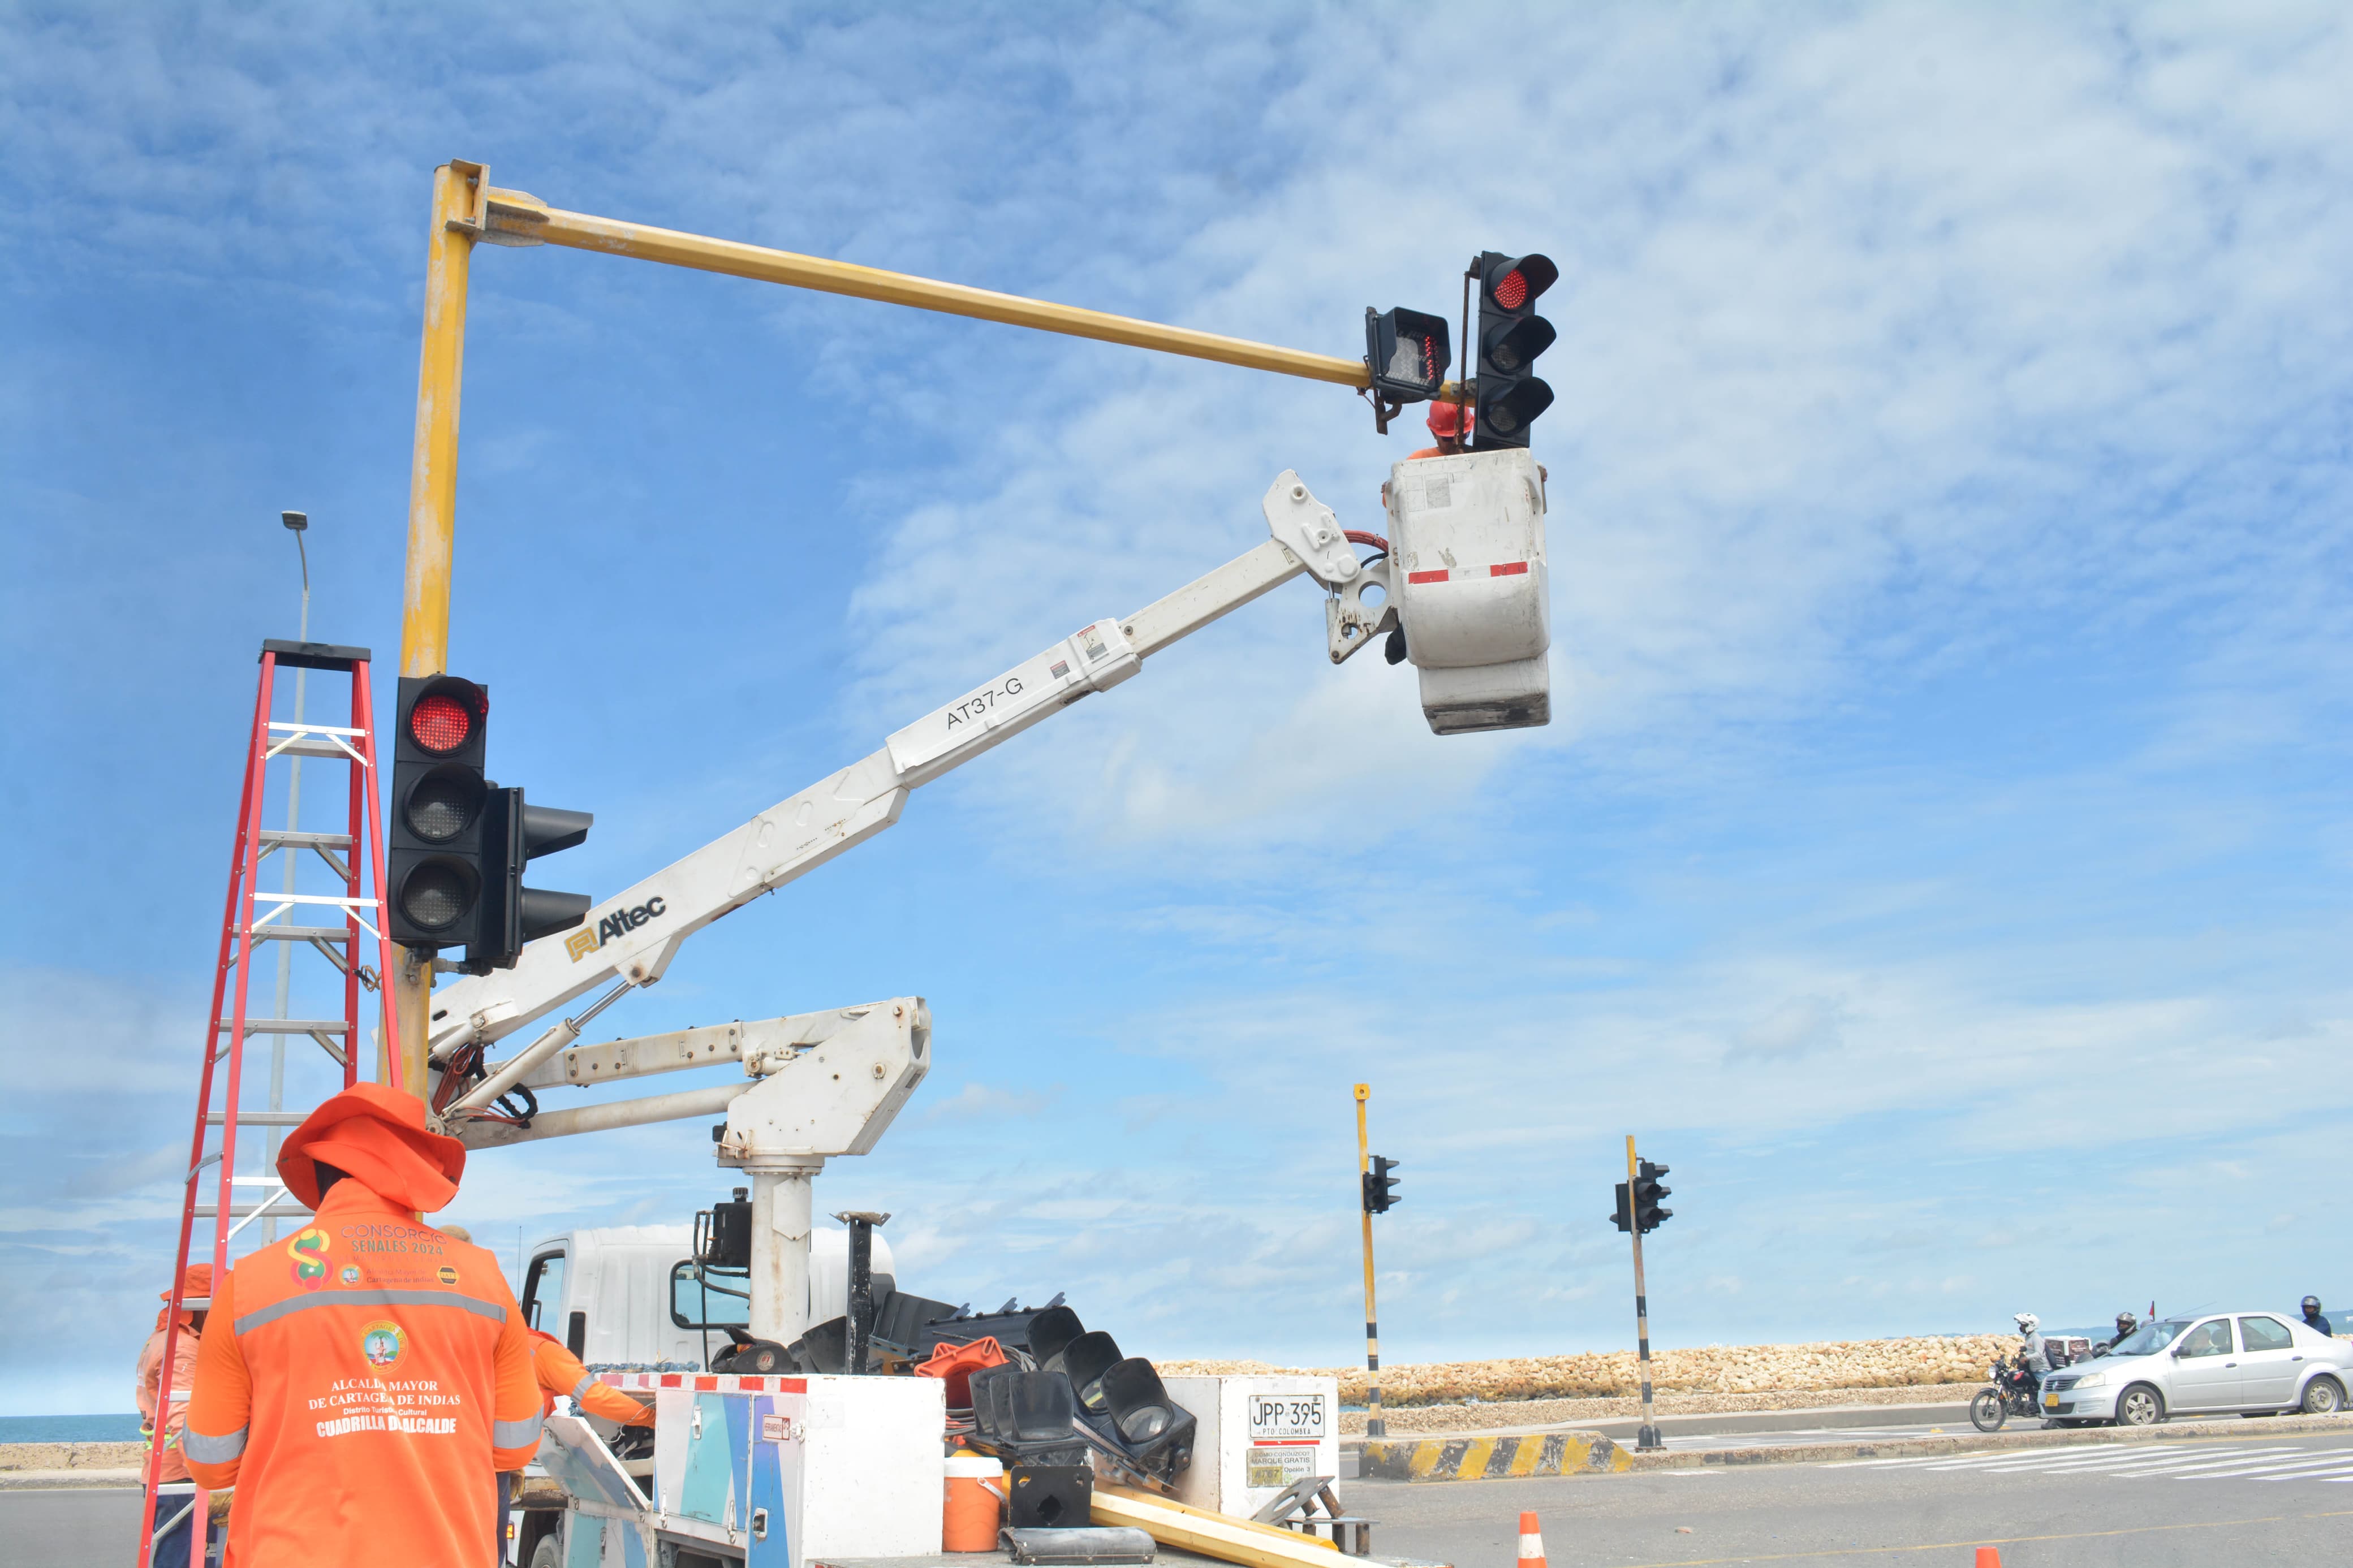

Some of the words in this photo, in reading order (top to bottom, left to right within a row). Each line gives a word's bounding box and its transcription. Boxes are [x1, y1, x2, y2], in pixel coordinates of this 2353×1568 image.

[947, 678, 1024, 729] AT37-G
[600, 895, 666, 947] Altec
[352, 1237, 407, 1252] SEÑALES
[412, 1242, 443, 1255] 2024
[389, 1380, 438, 1391] MAYOR
[308, 1398, 327, 1410] DE
[397, 1394, 415, 1405] DE
[419, 1394, 460, 1405] INDIAS
[343, 1406, 370, 1415] Distrito
[1253, 1403, 1284, 1426] JPP
[1290, 1403, 1321, 1425] 395
[317, 1415, 386, 1437] CUADRILLA
[403, 1418, 457, 1434] ALCALDE
